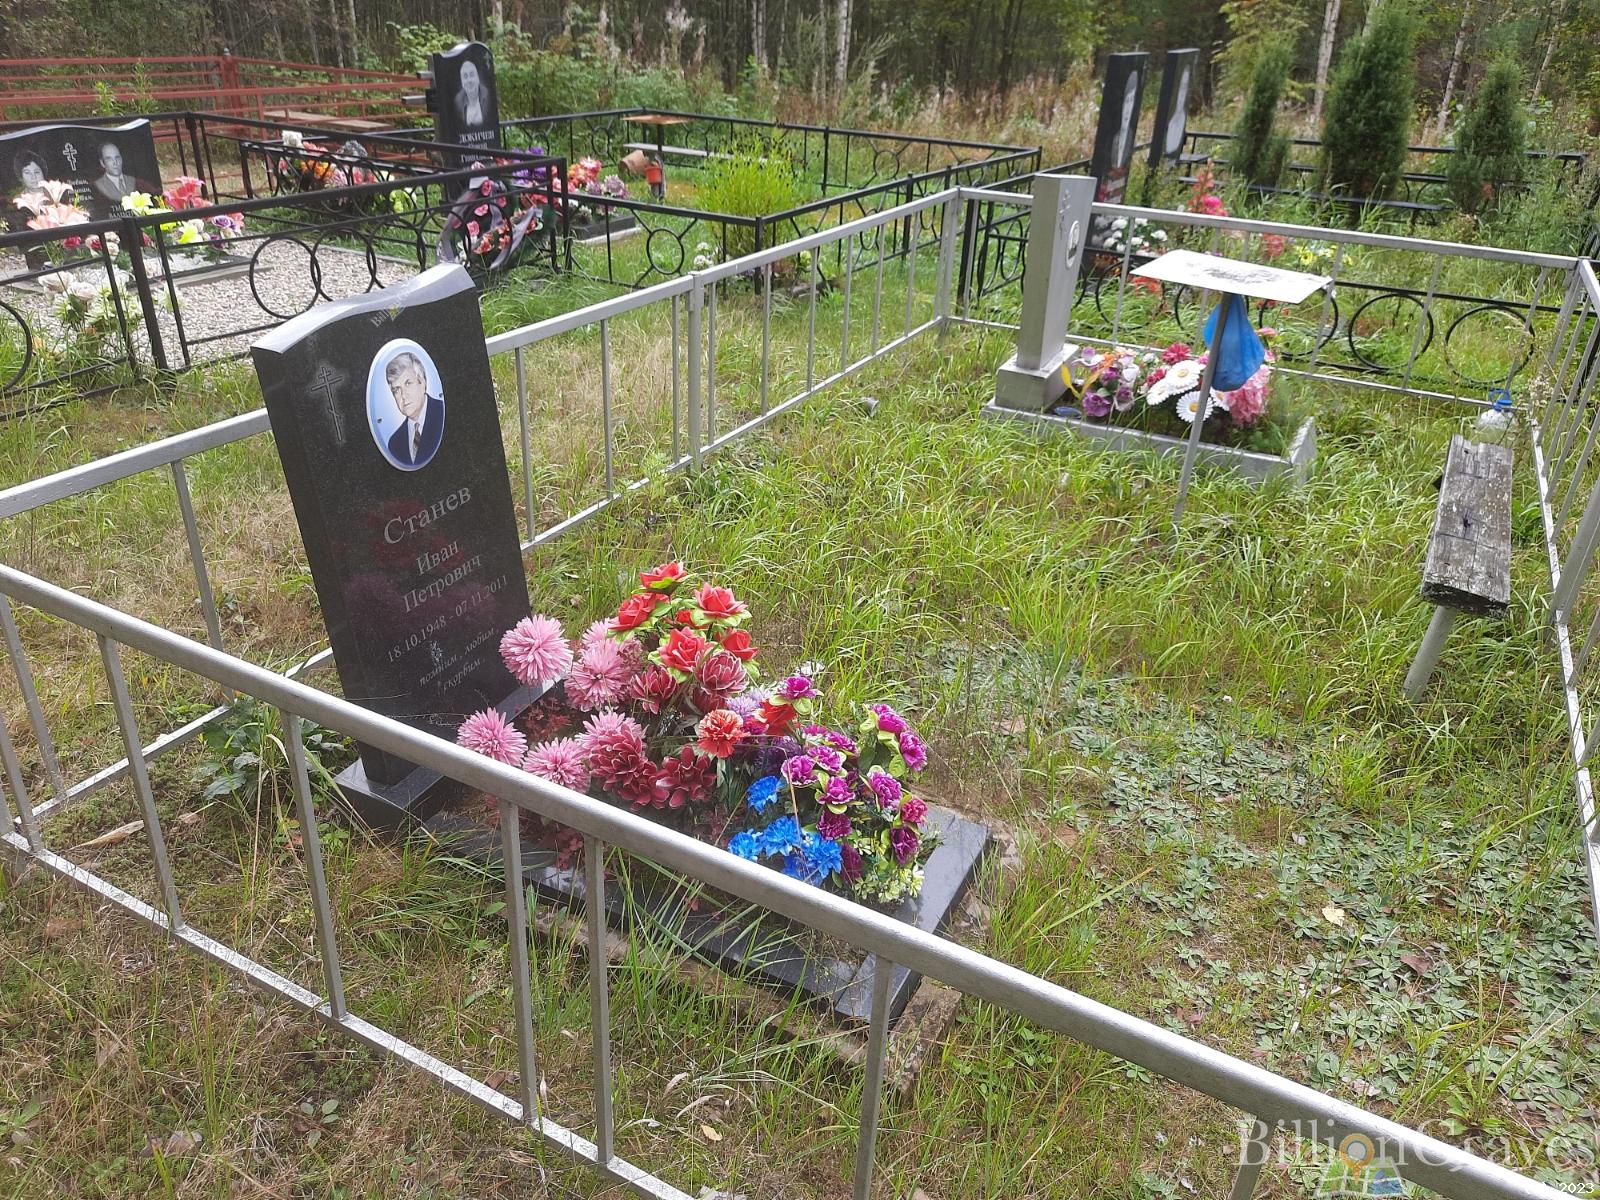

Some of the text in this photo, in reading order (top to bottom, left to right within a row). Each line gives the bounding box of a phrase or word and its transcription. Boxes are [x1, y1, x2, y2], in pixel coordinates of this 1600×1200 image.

[383, 487, 473, 544] Станев
[403, 555, 482, 612] Петрович
[415, 541, 459, 576] Иван
[387, 614, 447, 663] 18.10.1948
[455, 574, 508, 616] 07.11.2011
